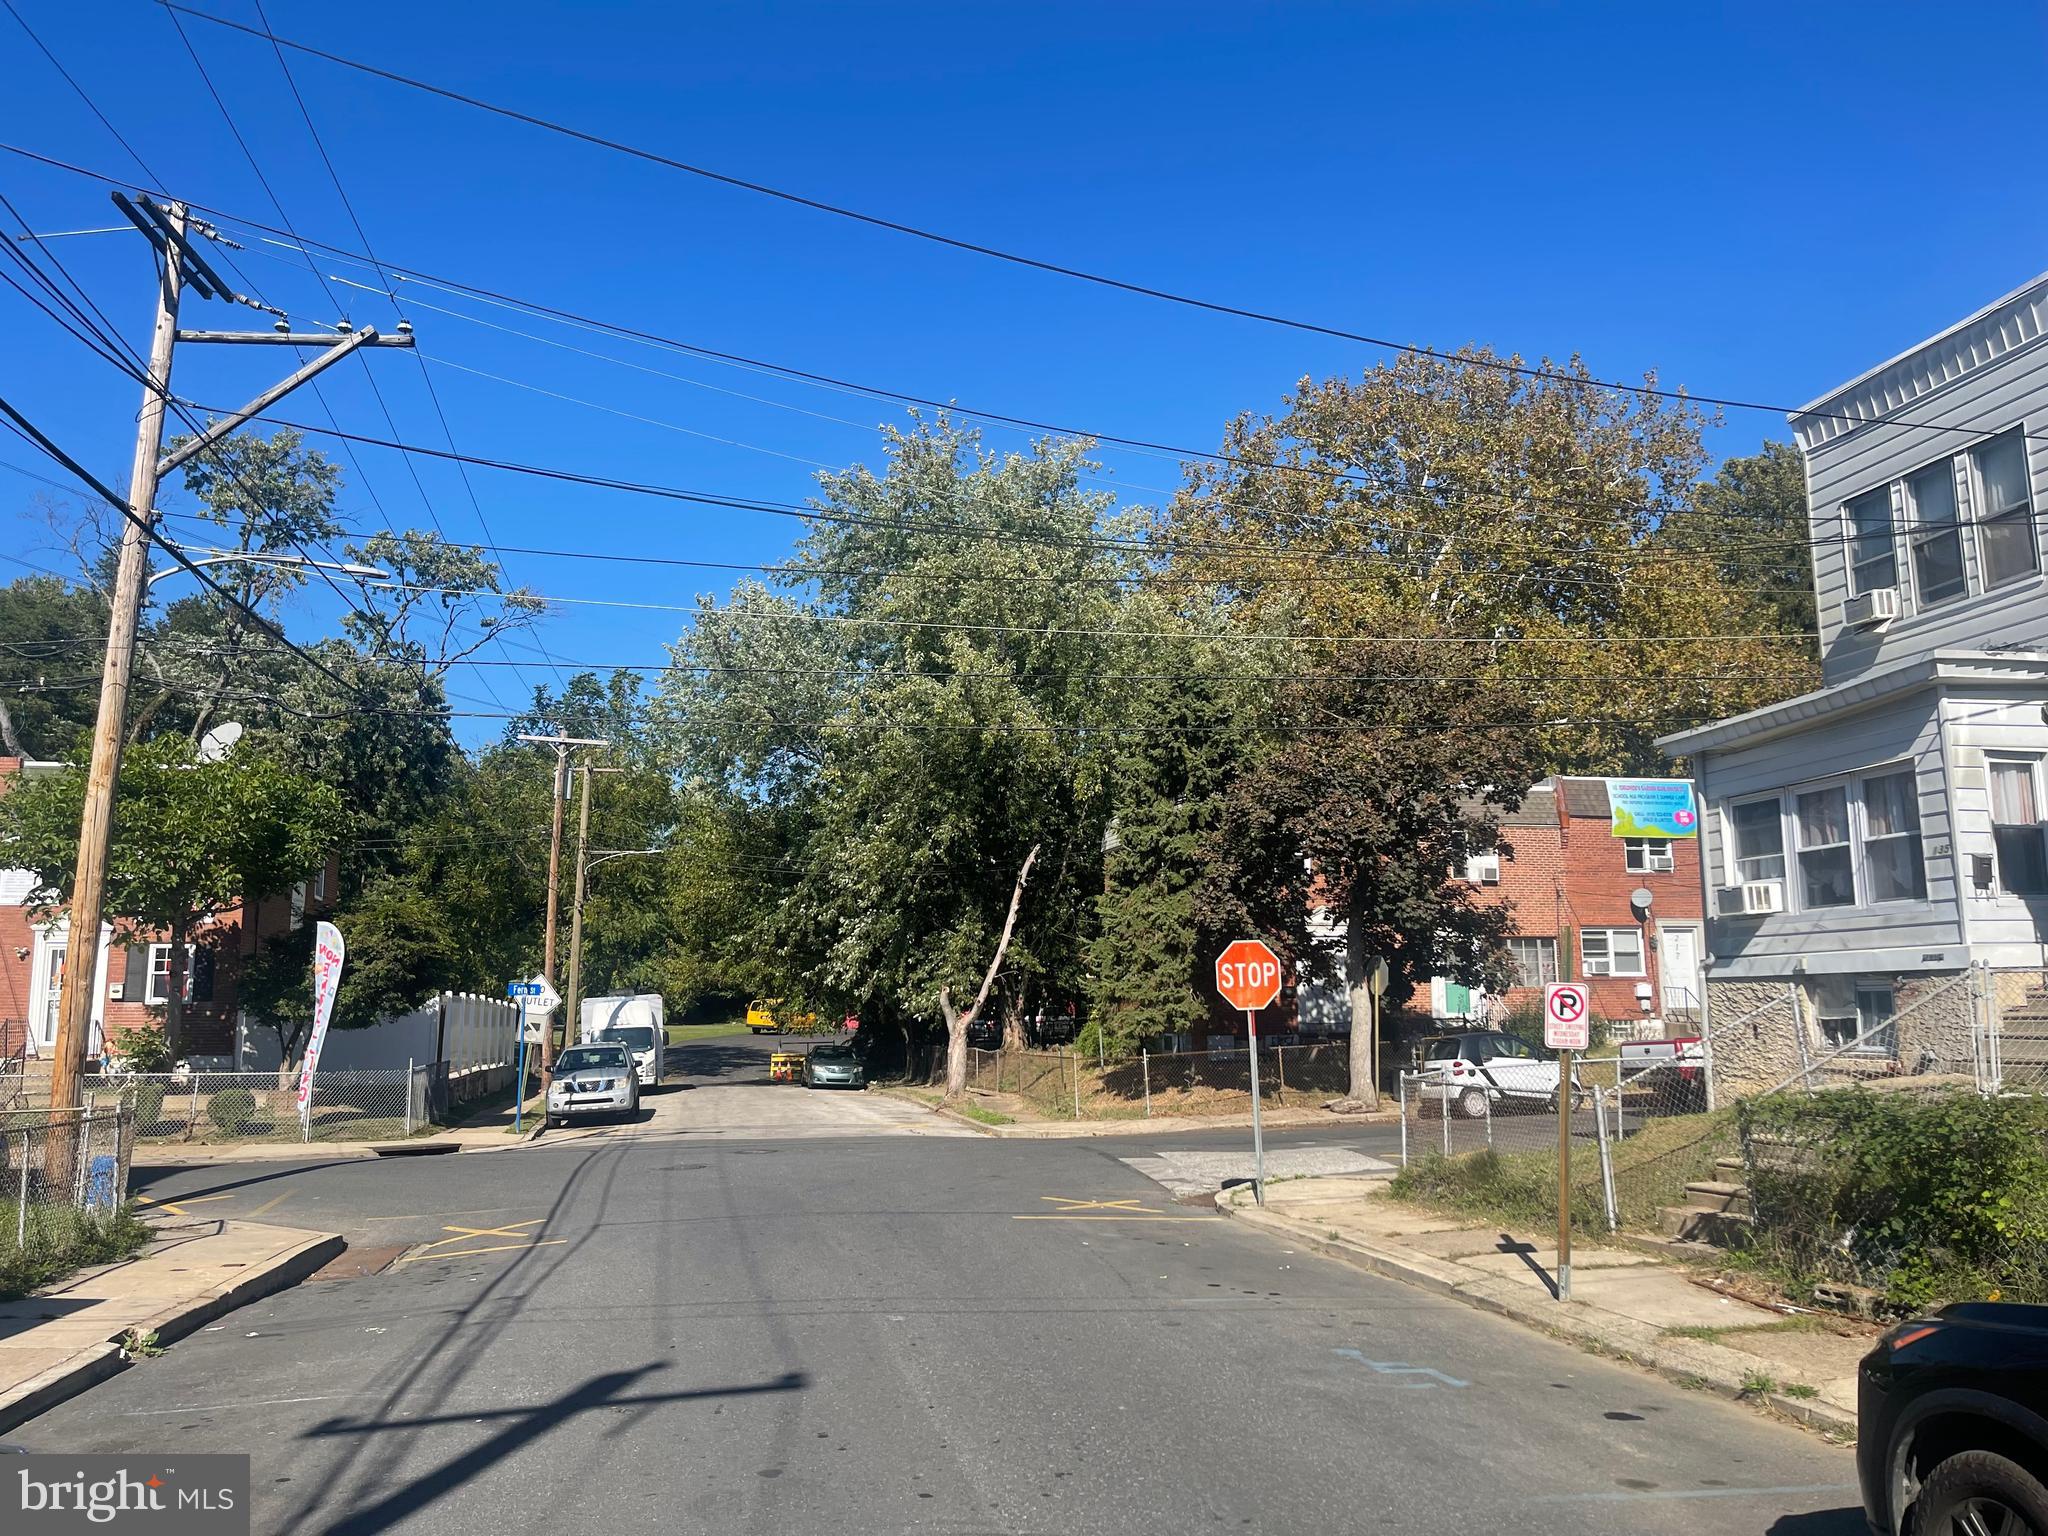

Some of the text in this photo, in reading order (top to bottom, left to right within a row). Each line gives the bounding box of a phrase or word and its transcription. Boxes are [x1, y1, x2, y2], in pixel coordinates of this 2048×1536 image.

[1932, 843, 1951, 855] 135
[1221, 962, 1276, 989] STOP
[513, 985, 528, 994] Fern
[526, 997, 554, 1006] UTLET
